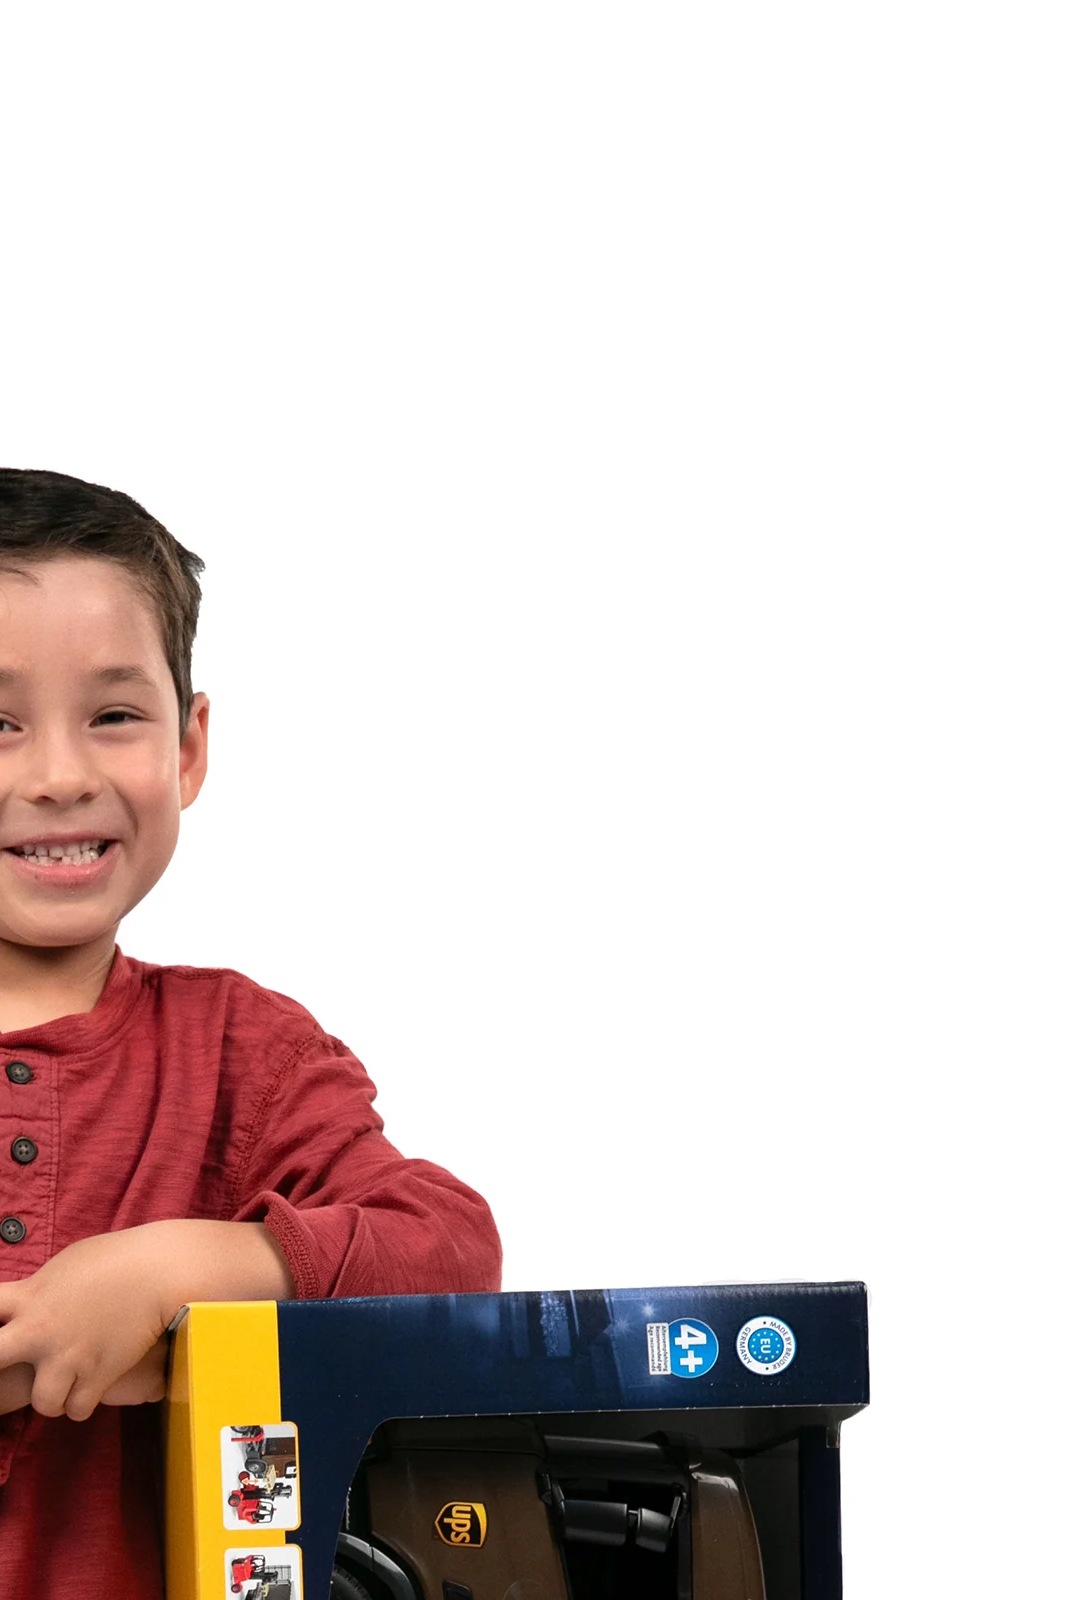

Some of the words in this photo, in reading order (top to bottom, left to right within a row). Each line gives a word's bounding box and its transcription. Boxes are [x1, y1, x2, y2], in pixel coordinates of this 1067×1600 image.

[770, 1321, 789, 1337] MADE
[675, 1324, 707, 1373] 4+
[739, 1326, 752, 1365] GERMANY
[760, 1338, 771, 1354] EU
[784, 1336, 792, 1346] BY
[772, 1347, 792, 1370] BRUDER
[443, 1505, 471, 1543] ups
